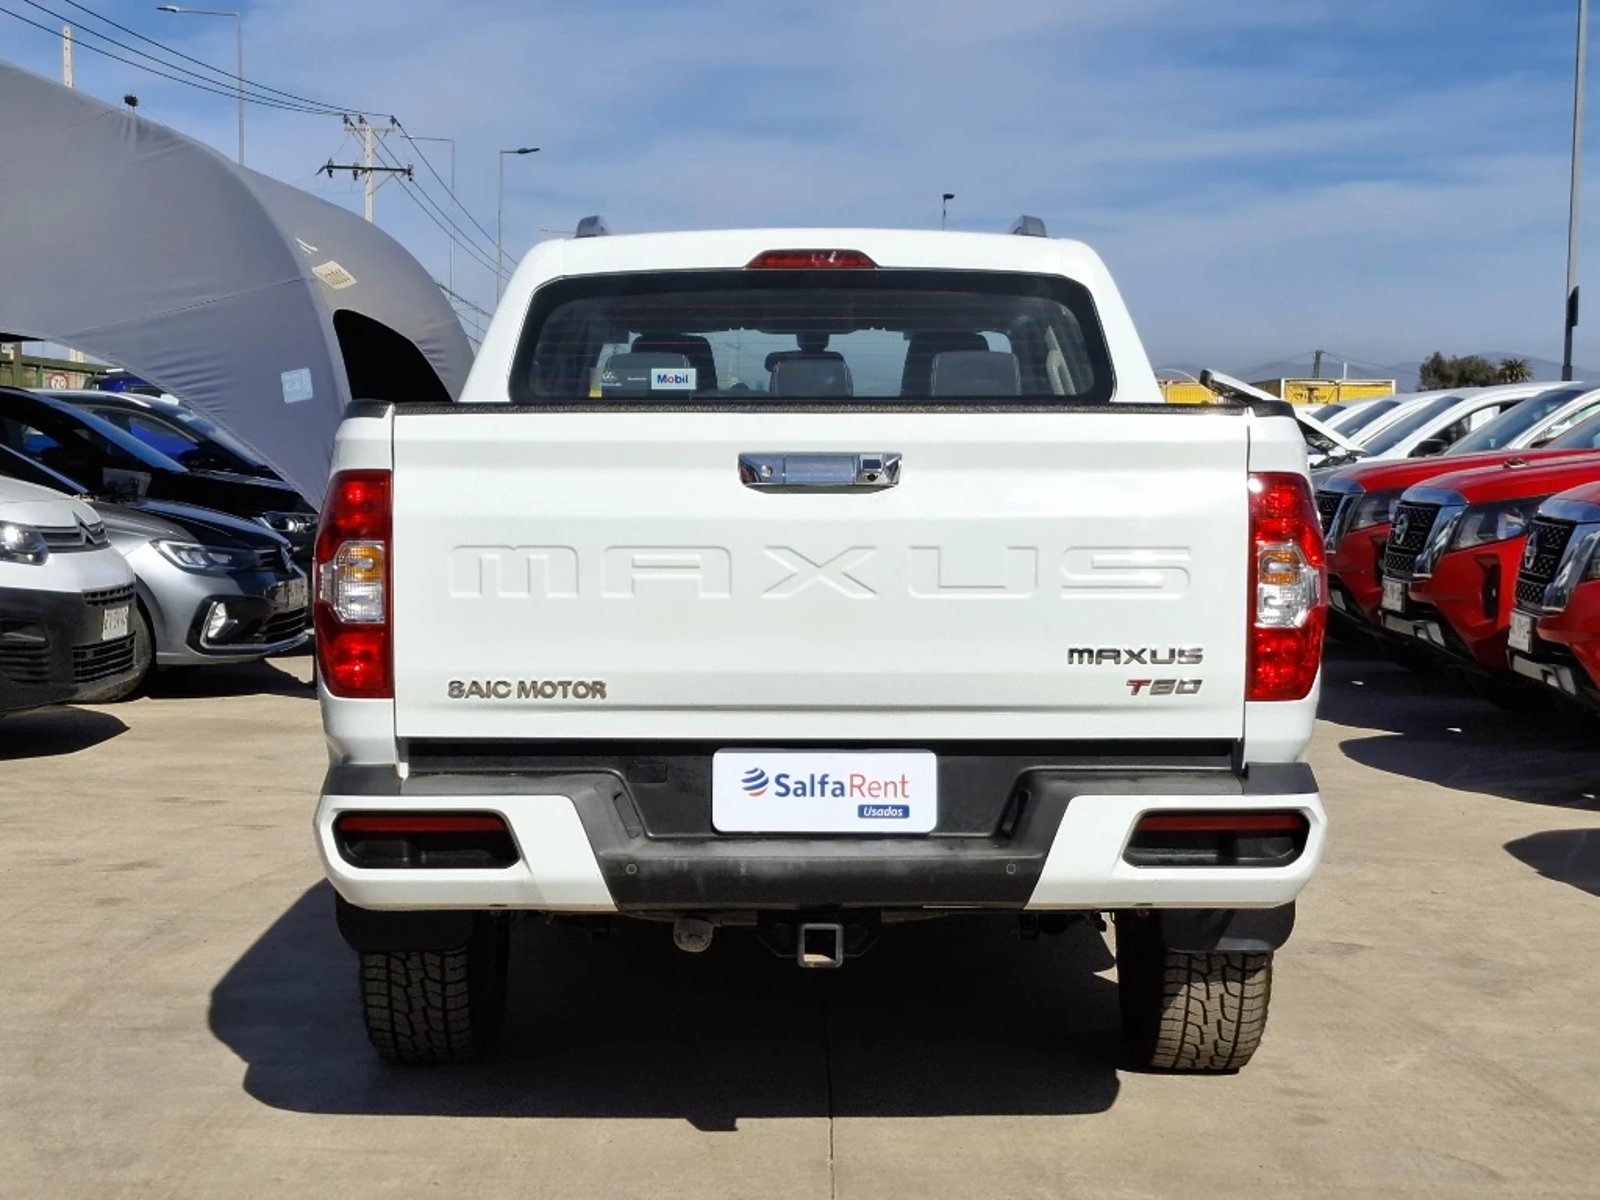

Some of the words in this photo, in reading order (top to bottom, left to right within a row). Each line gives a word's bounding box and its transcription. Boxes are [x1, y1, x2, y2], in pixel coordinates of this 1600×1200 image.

[656, 374, 689, 385] Mobil
[449, 545, 1192, 600] MAXUS
[1067, 647, 1204, 665] MAXUS
[447, 680, 512, 699] SAIC
[516, 680, 607, 699] MOTOR
[774, 772, 911, 799] SalfaRent
[863, 806, 904, 817] Usados
